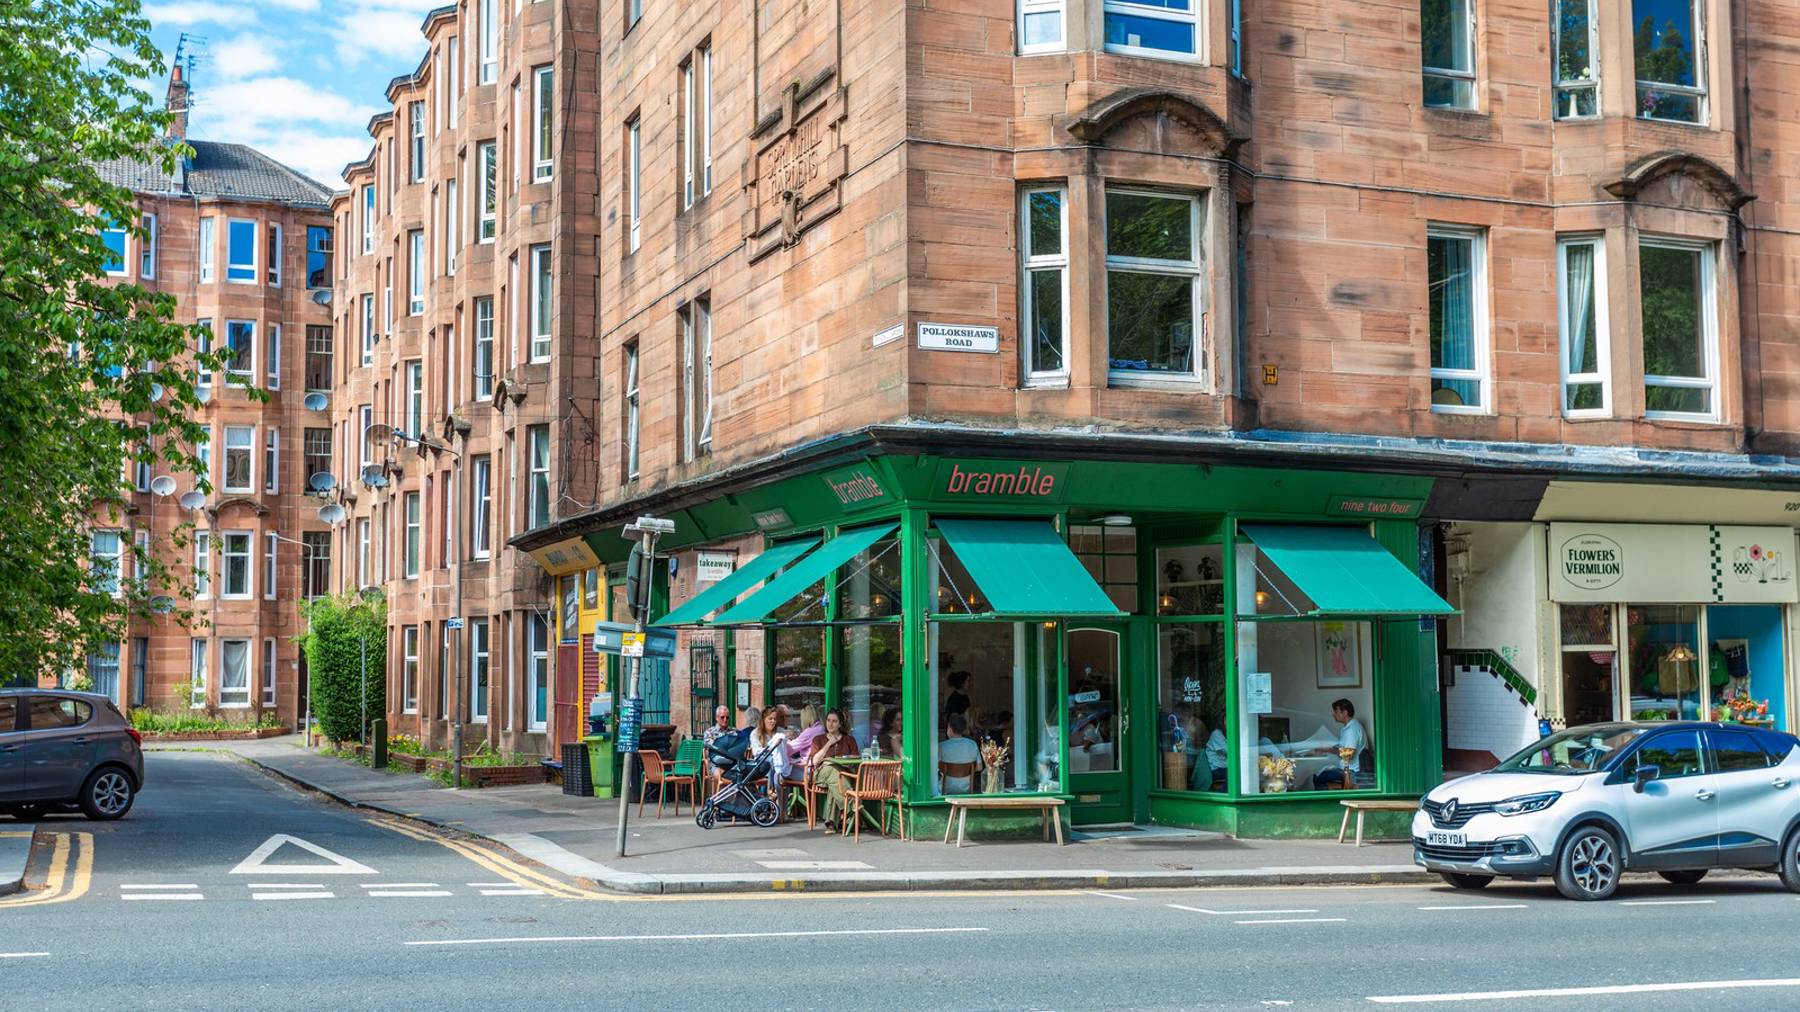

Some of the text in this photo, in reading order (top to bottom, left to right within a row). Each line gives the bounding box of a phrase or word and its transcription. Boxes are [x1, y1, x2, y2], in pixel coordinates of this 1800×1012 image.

[922, 327, 995, 338] POLLOKSHAWS
[945, 338, 973, 347] ROAD
[948, 464, 1055, 496] bramble
[827, 471, 883, 504] bramble
[1340, 501, 1410, 514] nine two four
[1568, 548, 1616, 562] FLOWERS
[699, 558, 732, 570] takeaway
[1566, 562, 1620, 575] VERMILION
[1429, 833, 1463, 845] MT68 YDA
